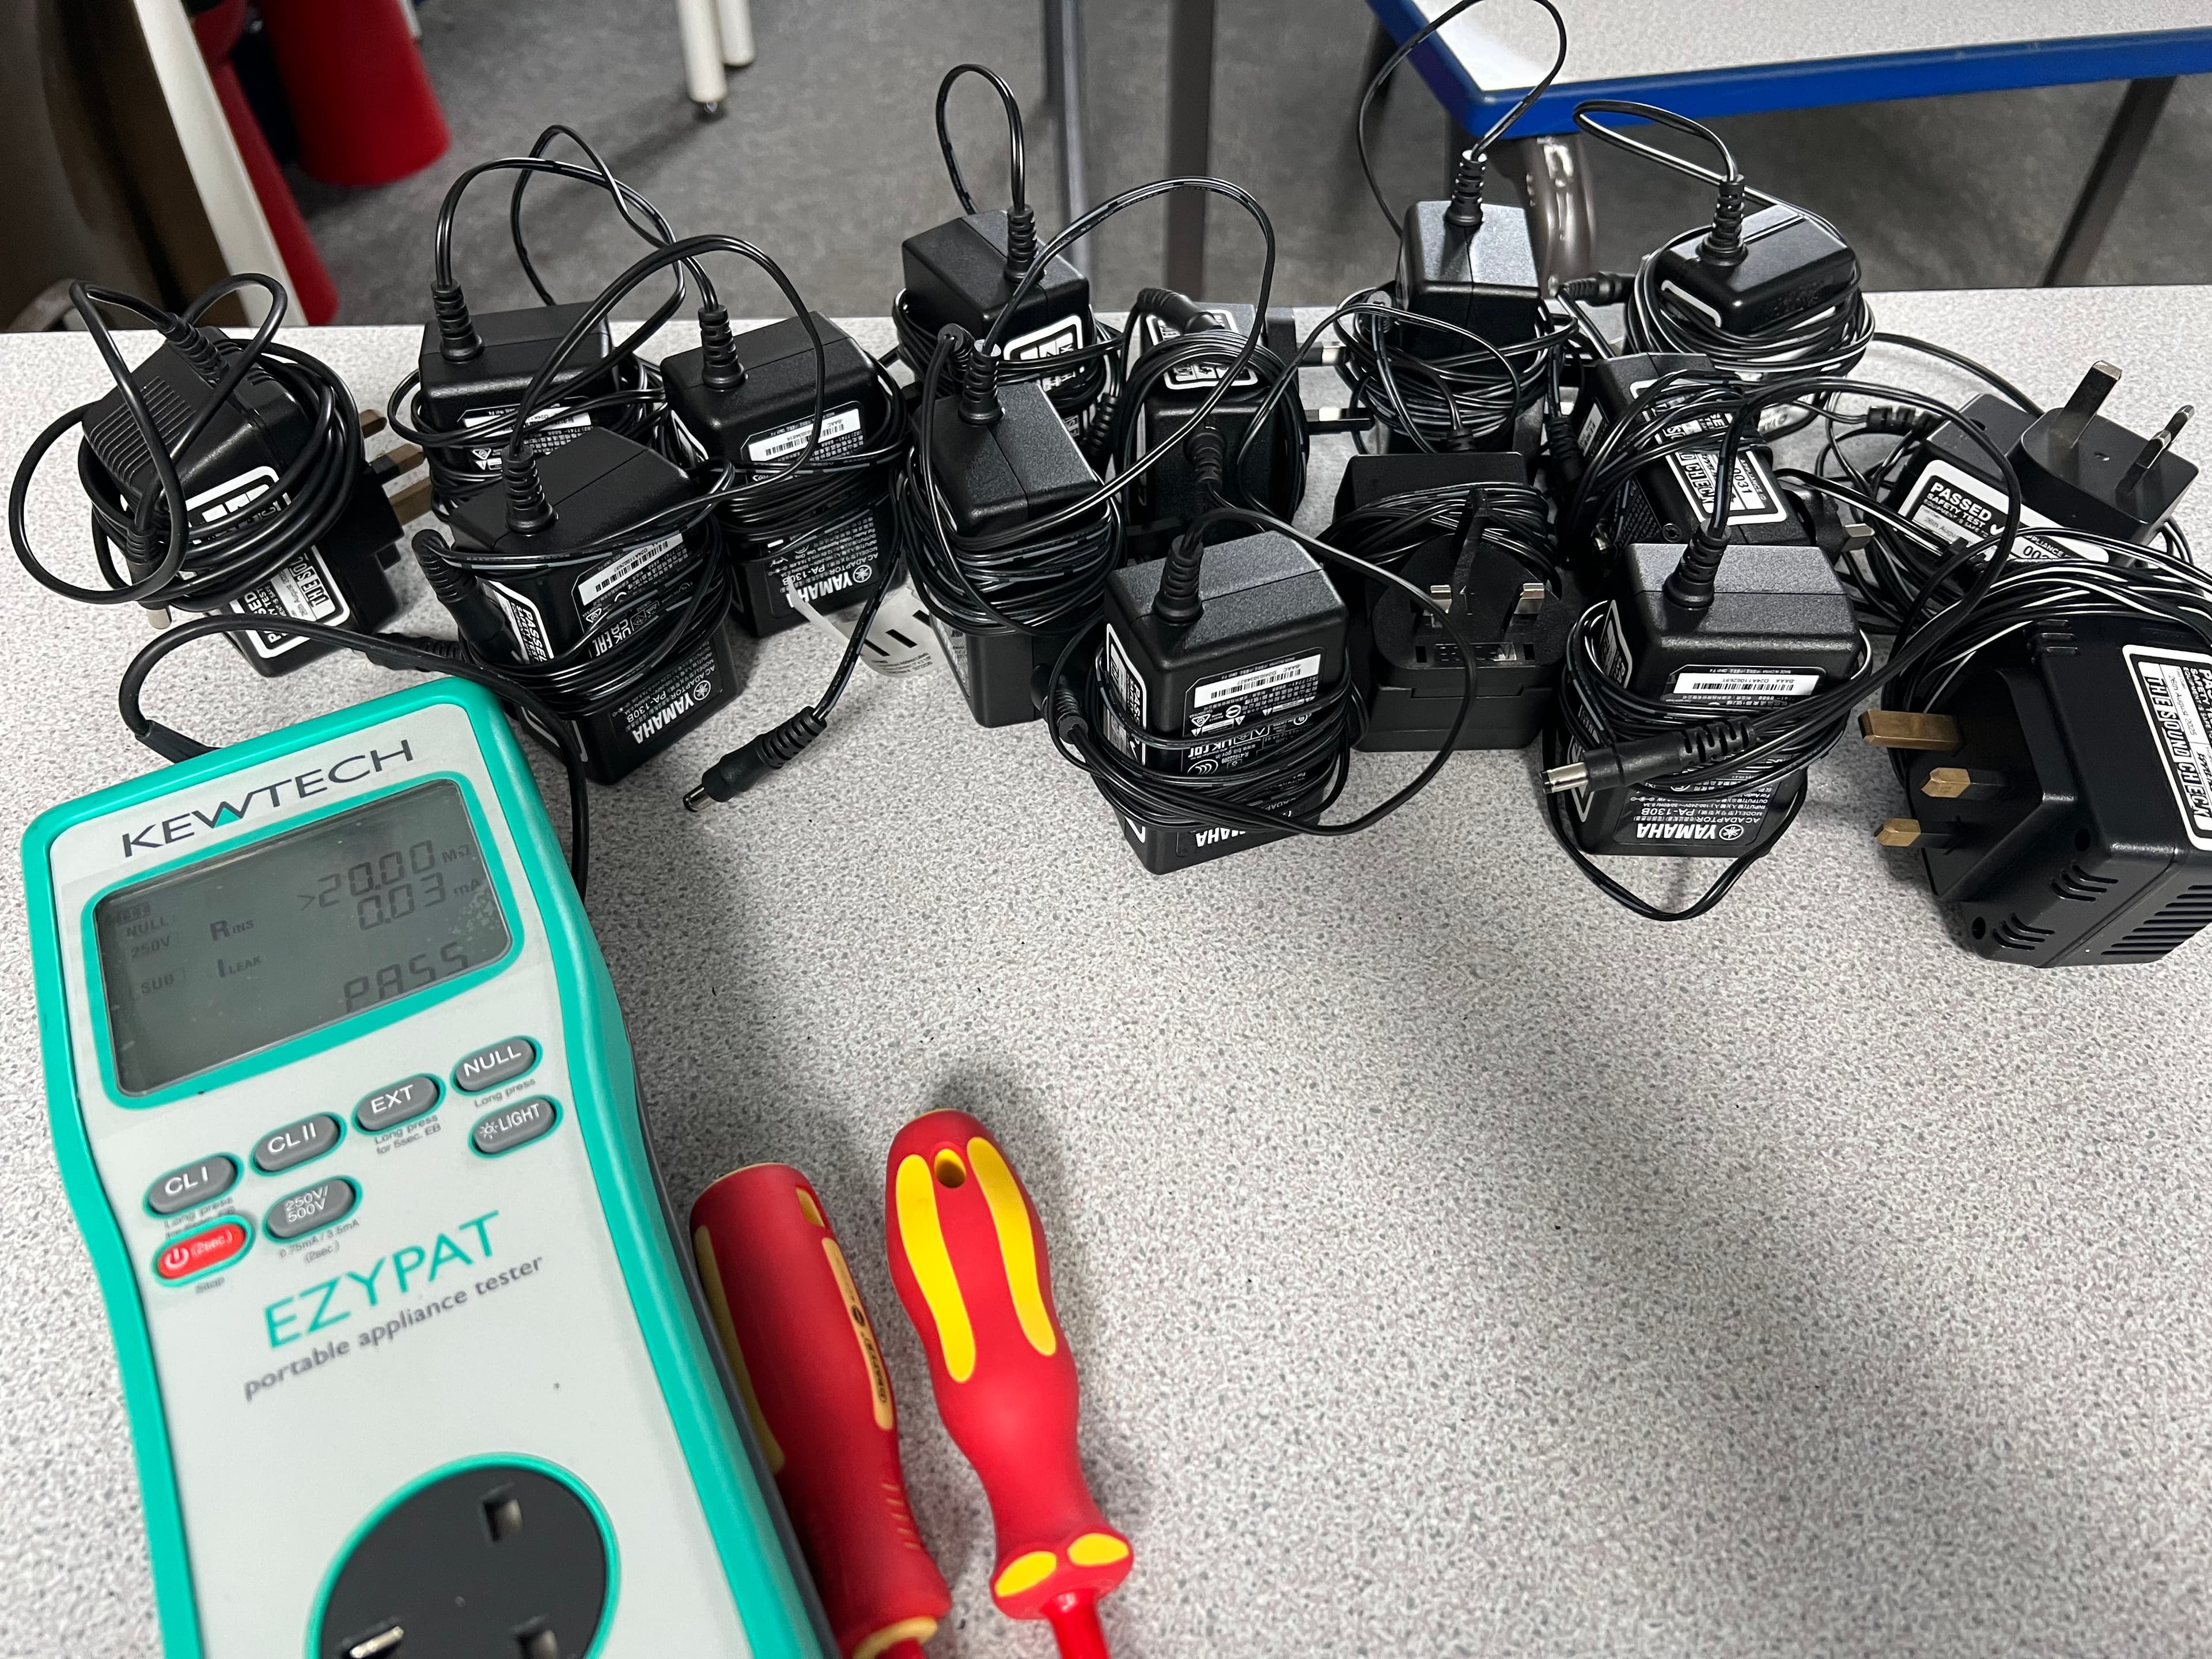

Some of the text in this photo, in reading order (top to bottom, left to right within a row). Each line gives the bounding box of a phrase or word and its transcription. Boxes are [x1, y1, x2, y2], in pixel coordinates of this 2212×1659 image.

[1685, 462, 1715, 503] CHECK
[1927, 493, 1961, 514] SAFETY
[1963, 512, 1986, 528] TEST
[1930, 482, 1992, 521] PASSED
[2024, 535, 2065, 558] PLIANCE
[830, 552, 879, 575] AC ADAPTOR
[301, 579, 329, 608] THE
[244, 592, 282, 643] PSED
[516, 605, 532, 639] SAFETY
[611, 619, 630, 635] CA
[614, 627, 632, 645] UK
[671, 664, 715, 700] AC ADAPTOR
[2183, 666, 2202, 704] EQUIPMENT
[2191, 668, 2211, 705] SAFETY
[627, 690, 666, 722] PA-130B
[632, 692, 694, 744] YAMAHA
[2175, 692, 2189, 717] August
[2186, 718, 2197, 736] 2025
[2146, 678, 2173, 706] THE
[2161, 711, 2191, 757] SOUND
[2178, 763, 2211, 817] CHECK
[122, 739, 414, 858] KEWTECH
[1641, 808, 1695, 816] PA-130B
[1195, 827, 1246, 848] AHA
[1637, 823, 1717, 840] YAMAHA
[358, 872, 446, 931] 0.03
[453, 878, 482, 895] mA
[126, 916, 169, 938] NULL
[131, 935, 171, 960] 250V
[141, 974, 175, 995] SUB
[344, 941, 469, 1013] PASS
[463, 1046, 522, 1077] NULL
[371, 1084, 414, 1114] EXT
[474, 1078, 536, 1108] Long press
[375, 1115, 438, 1145] Long press
[425, 1124, 442, 1137] EB
[497, 1103, 540, 1131] LIGHT
[267, 1132, 301, 1154] CL
[164, 1173, 199, 1195] CL
[285, 1184, 329, 1211] 250V/
[287, 1197, 327, 1223] 500V
[264, 1210, 499, 1349] EZYPAT
[243, 1256, 544, 1402] portable appliance tester
